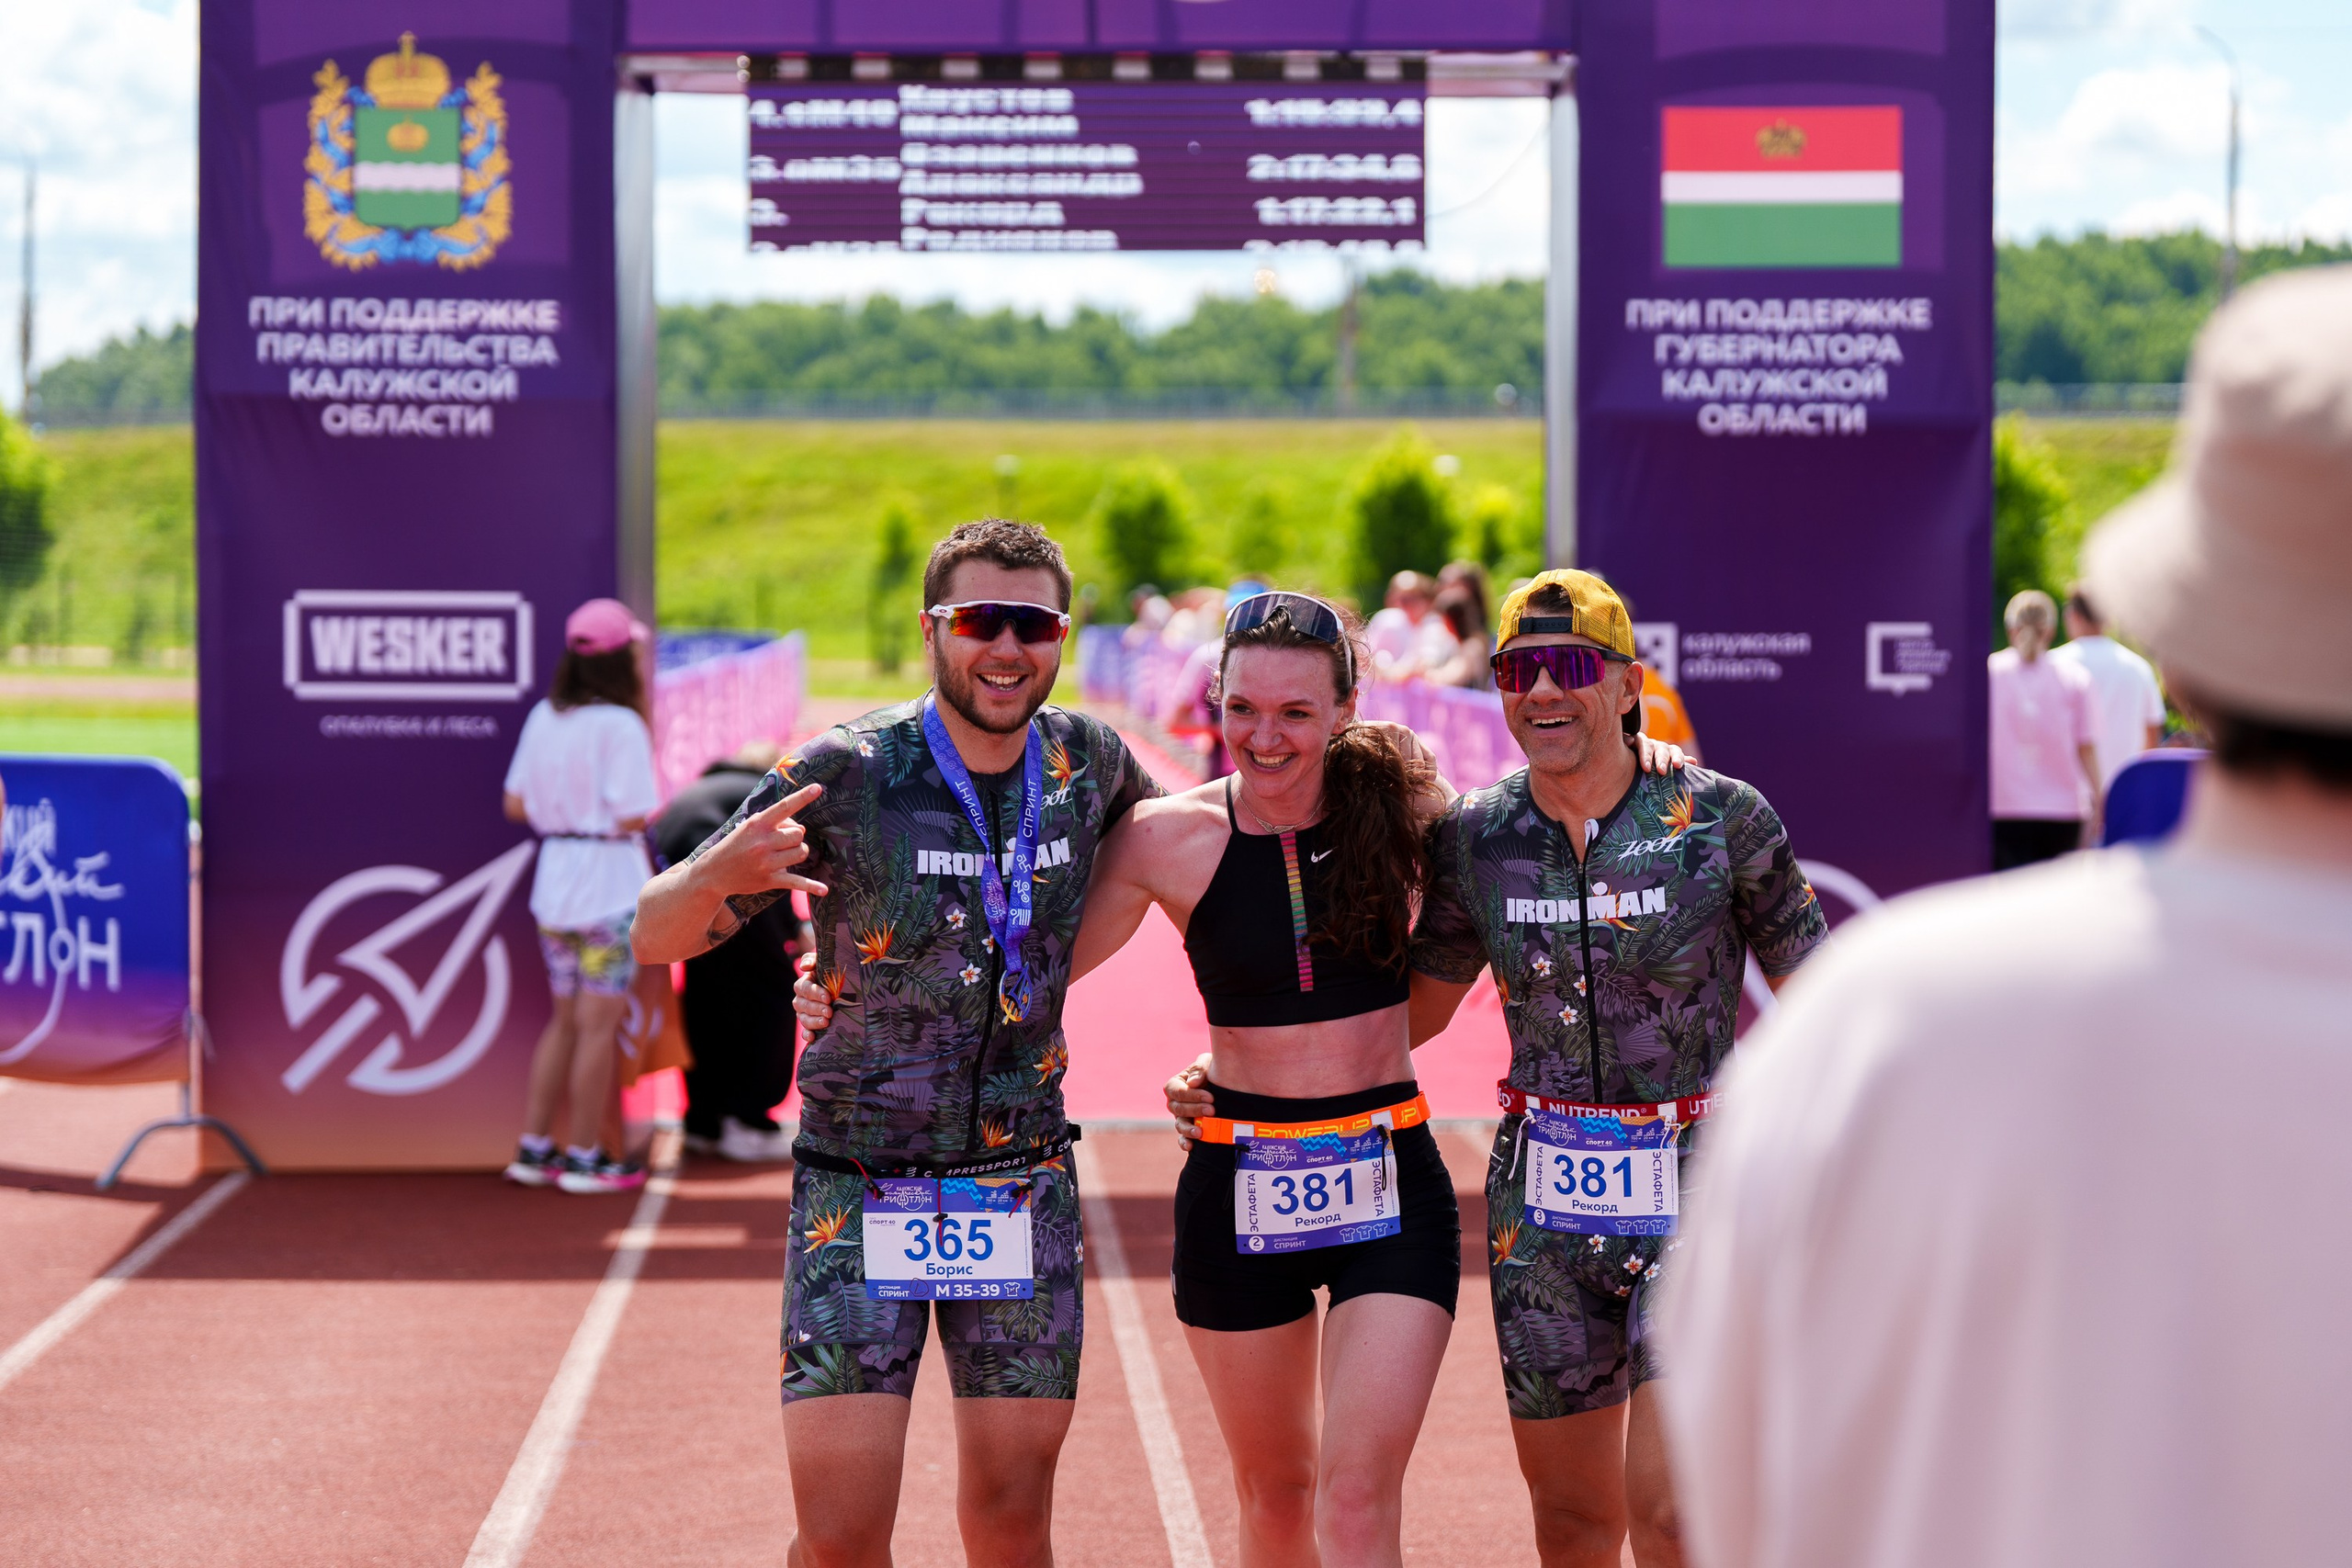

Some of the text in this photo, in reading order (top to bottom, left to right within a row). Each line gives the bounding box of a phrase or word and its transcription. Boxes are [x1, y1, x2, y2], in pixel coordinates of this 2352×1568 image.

[249, 296, 561, 332] ПРИ ПОДДЕРЖКЕ
[1625, 299, 1932, 332] ПРИ ПОДДЕРЖКЕ
[257, 332, 560, 366] ПРАВИТЕЛЬСТВА
[1655, 333, 1904, 366] ГУБЕРНАТОРА
[289, 365, 519, 401] КАЛУЖСКОЙ
[1662, 363, 1888, 401] КАЛУЖСКОЙ
[322, 403, 493, 437] ОБЛАСТИ
[1698, 402, 1867, 436] ОБЛАСТИ
[310, 615, 507, 675] WESKER
[1023, 778, 1037, 838] СПРИНТ
[1507, 882, 1666, 924] IRONMAN
[1272, 1168, 1354, 1215] 381
[1372, 1160, 1385, 1217] ЭСТАФЕТА
[1535, 1145, 1544, 1205] ЭСТАФЕТА
[1553, 1154, 1632, 1198] 381
[1652, 1152, 1663, 1213] ЭСТАФЕТА
[1248, 1173, 1259, 1233] ЭСТАФЕТА
[1295, 1213, 1341, 1227] Рекорд
[1535, 1211, 1543, 1220] 3
[1572, 1200, 1618, 1213] Рекорд
[903, 1219, 993, 1261] 365
[1252, 1237, 1261, 1247] 2
[1552, 1221, 1581, 1230] СПРИНТ
[1274, 1240, 1306, 1249] СПРИНТ
[926, 1263, 973, 1278] Борис
[878, 1290, 910, 1298] СПРИНТ
[954, 1283, 1001, 1297] 35-39
